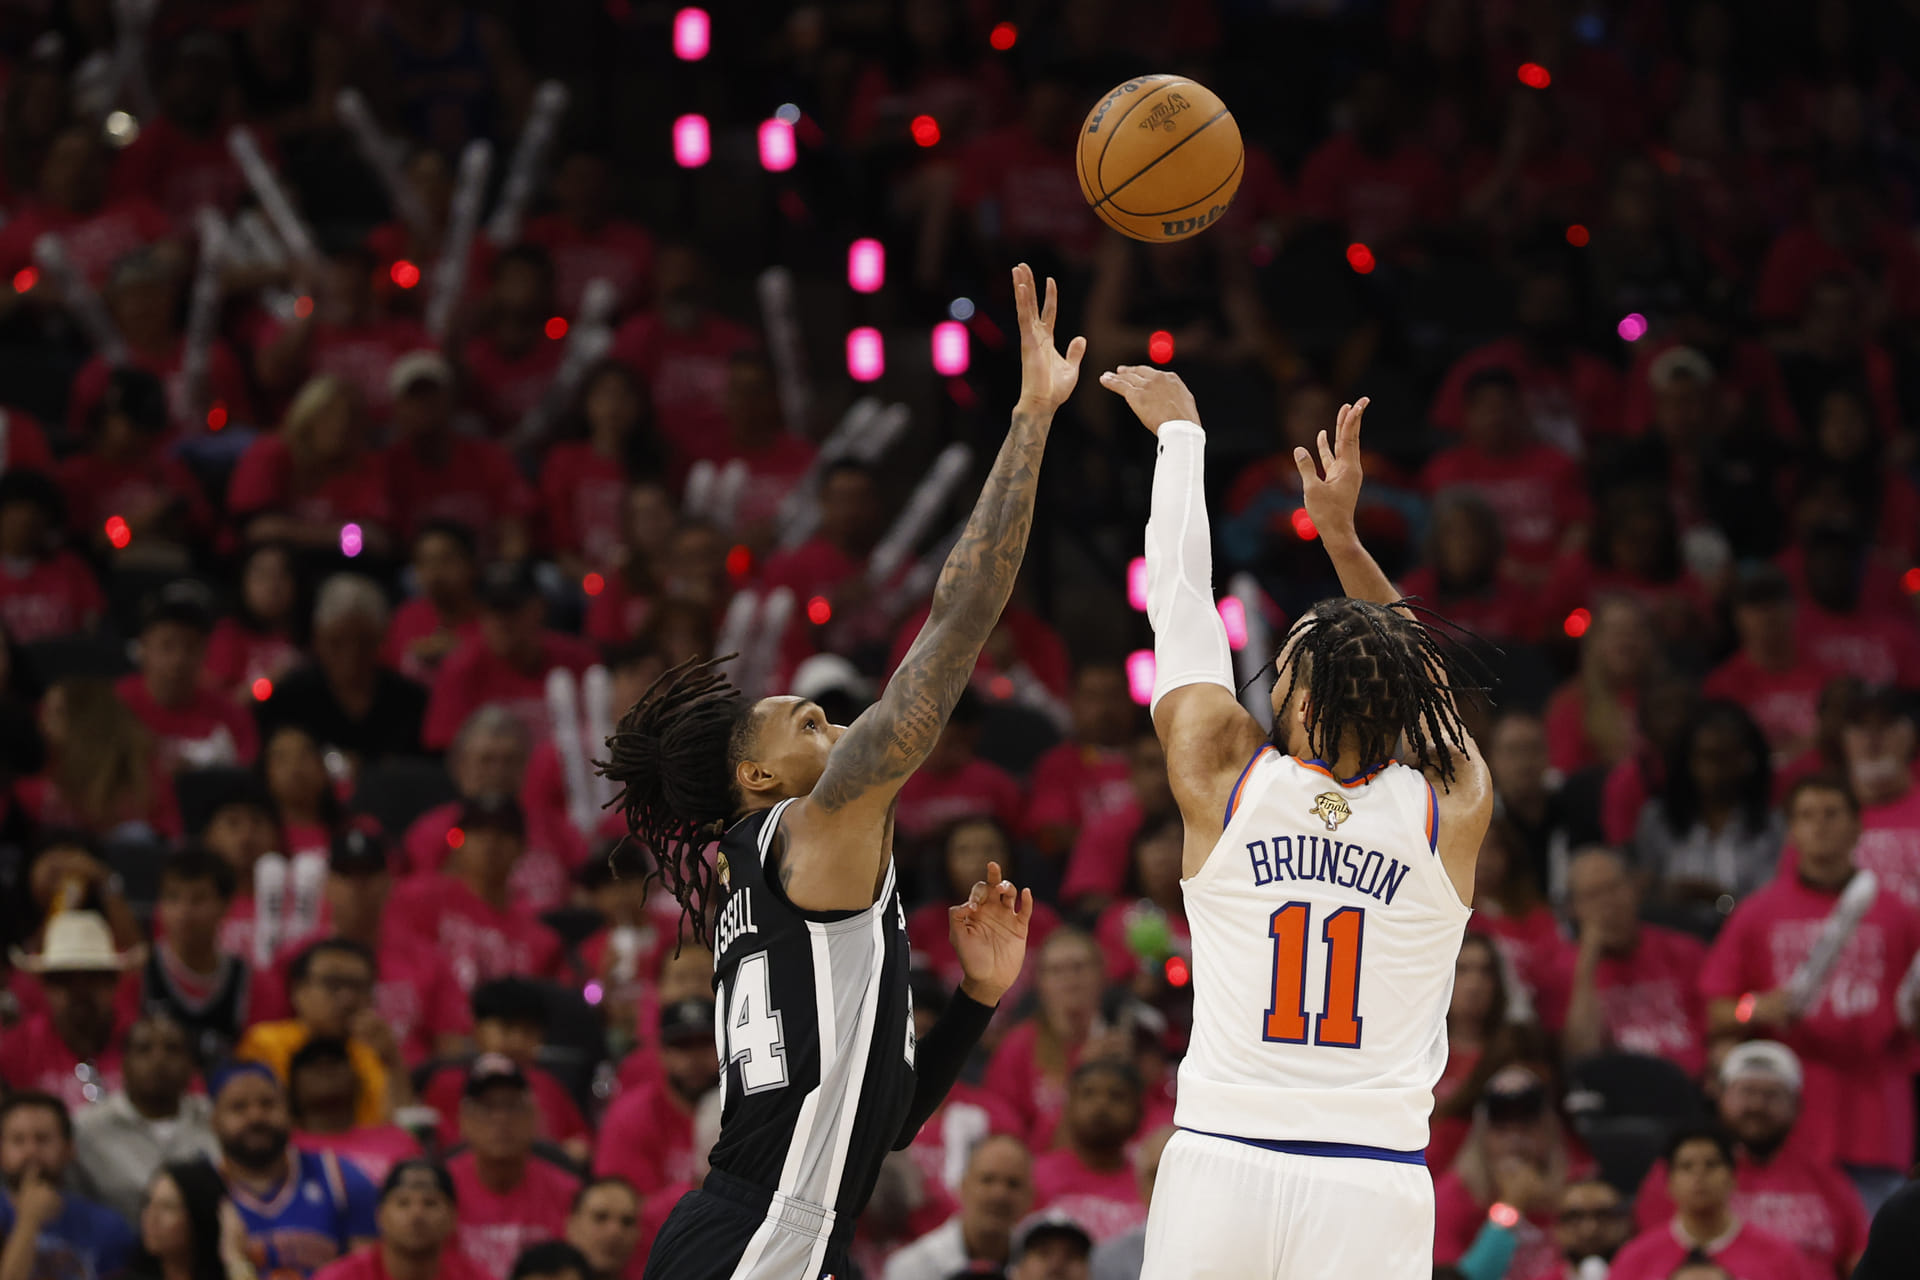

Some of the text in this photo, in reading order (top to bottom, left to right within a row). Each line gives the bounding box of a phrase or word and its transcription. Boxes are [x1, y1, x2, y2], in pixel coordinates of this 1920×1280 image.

[1317, 795, 1351, 814] Finals
[1246, 835, 1410, 905] BRUNSON
[1262, 900, 1365, 1050] 11
